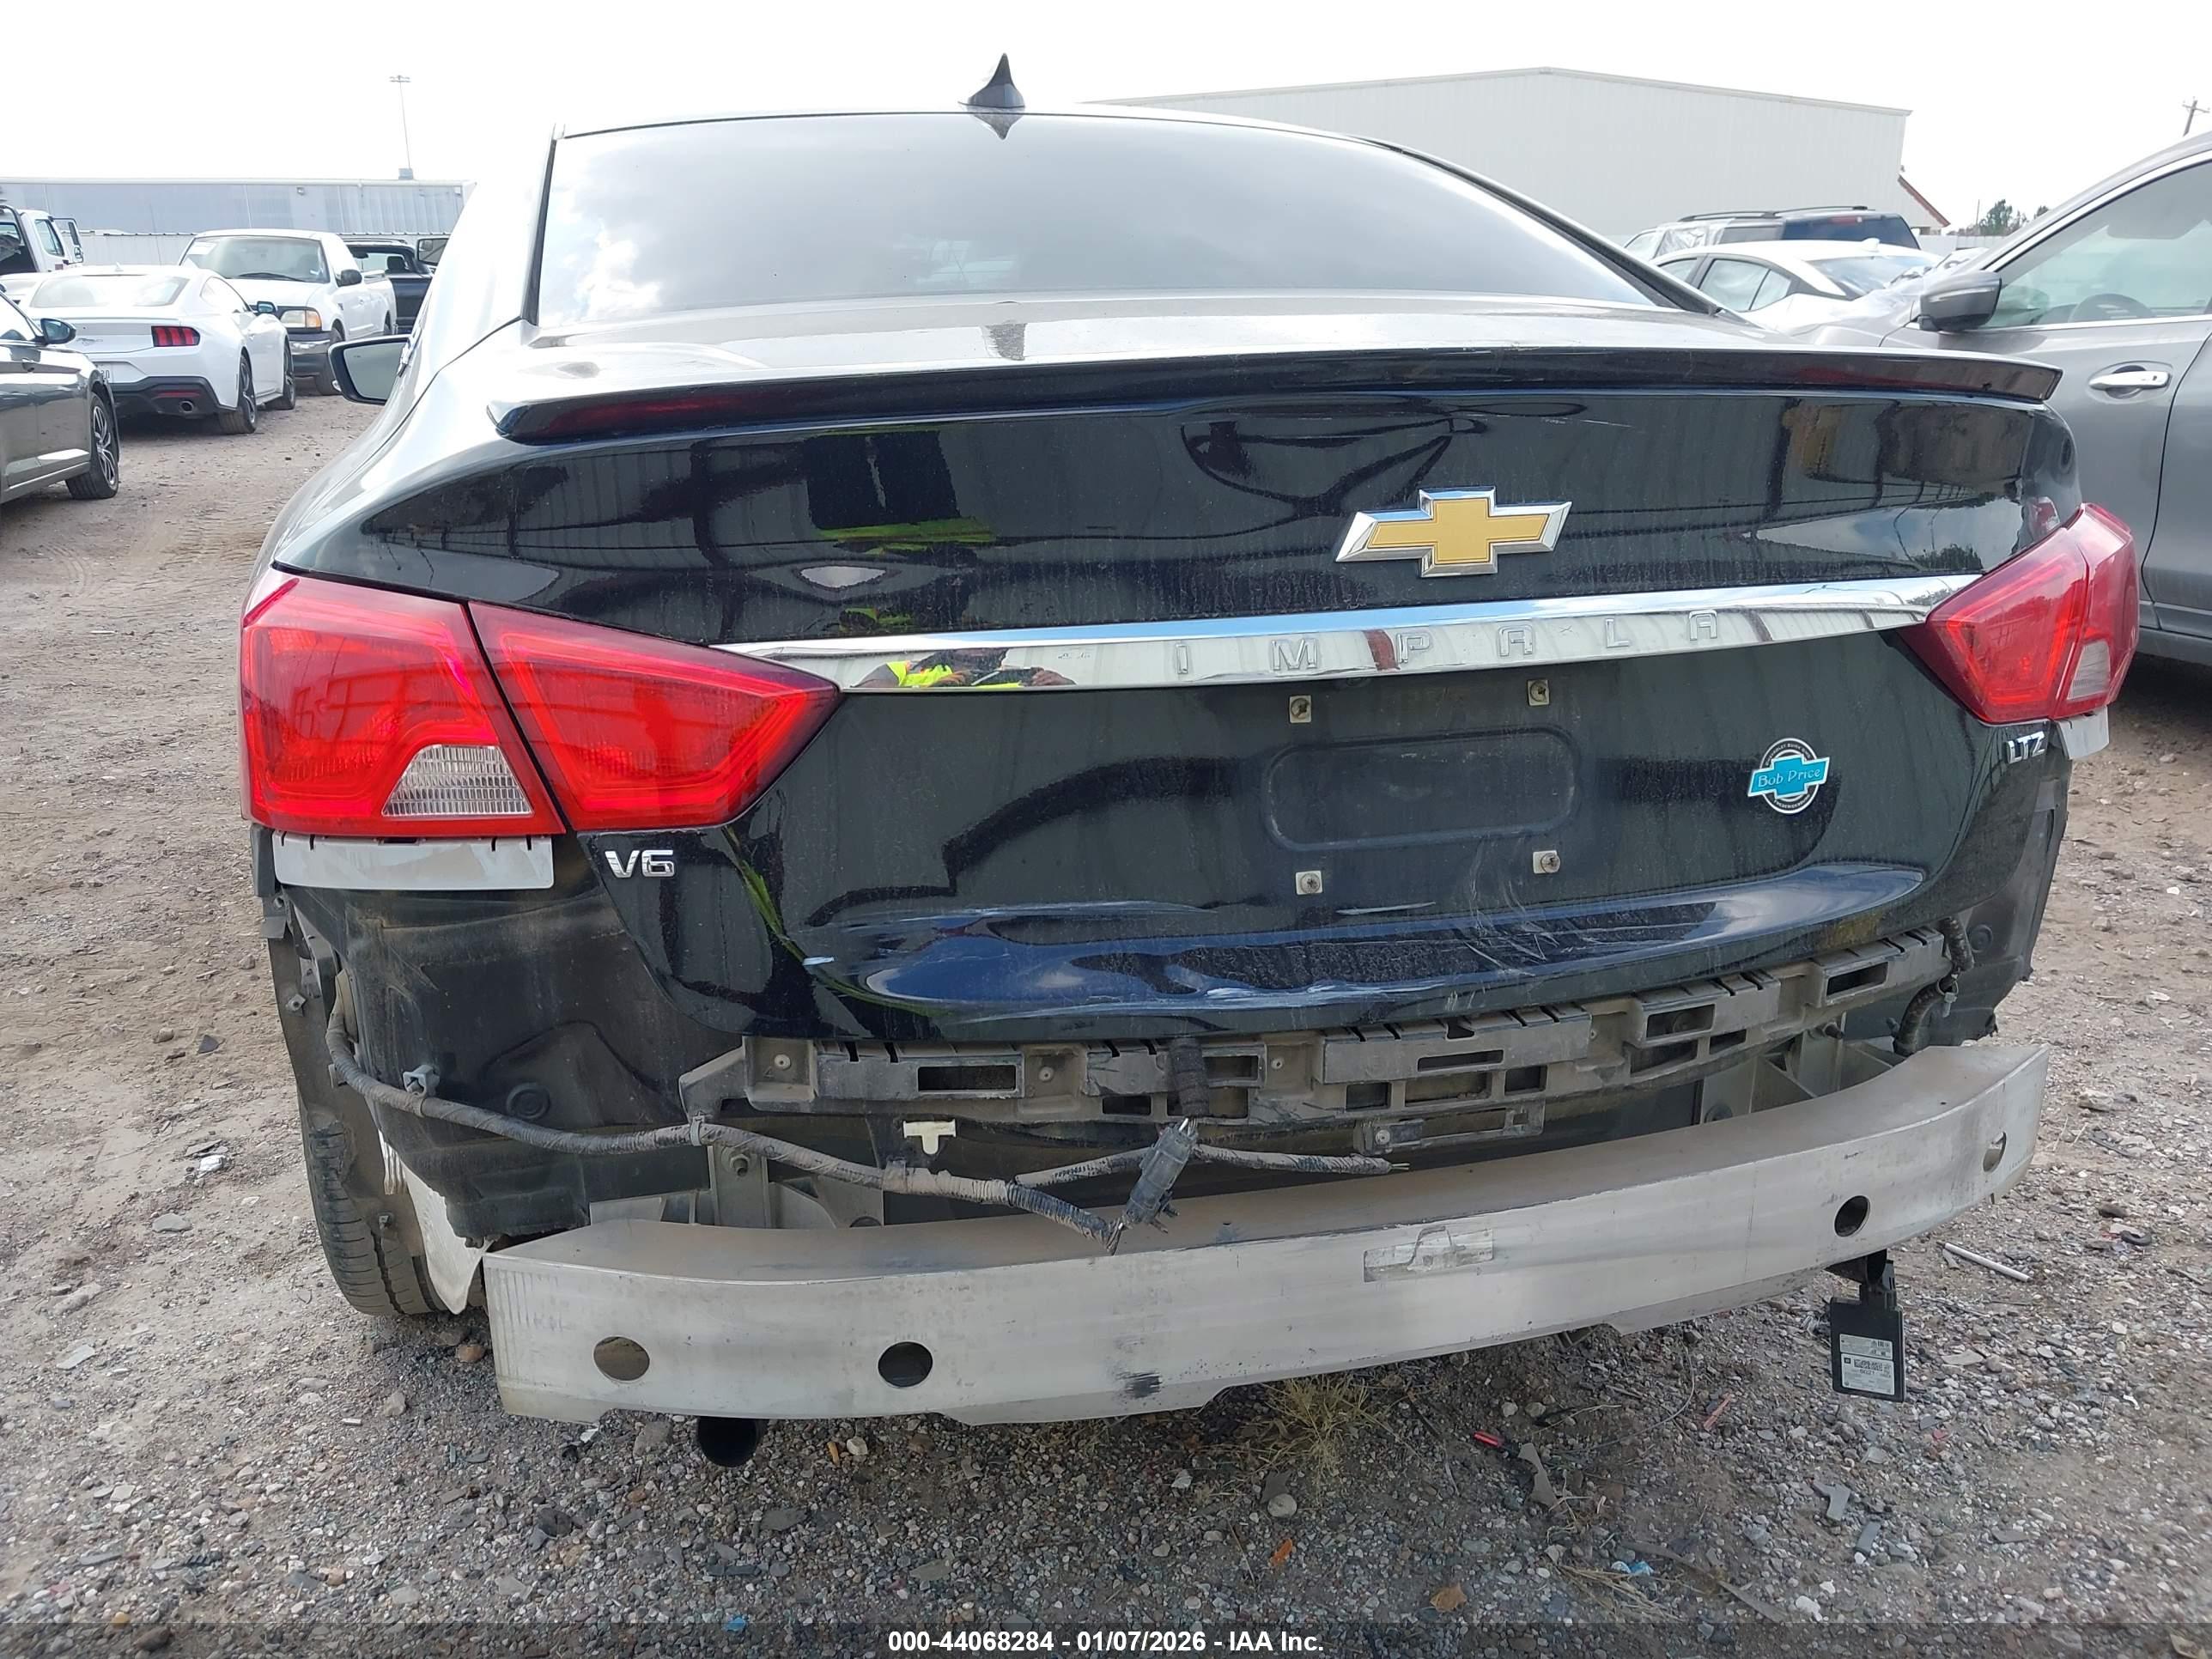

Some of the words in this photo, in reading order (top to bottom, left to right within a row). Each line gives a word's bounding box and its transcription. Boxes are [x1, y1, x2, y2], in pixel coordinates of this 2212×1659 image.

[1176, 609, 1718, 675] IMPALA
[2007, 731, 2045, 764] LTZ
[1758, 773, 1784, 787] Bob
[1787, 769, 1820, 782] Price
[605, 849, 675, 878] V6
